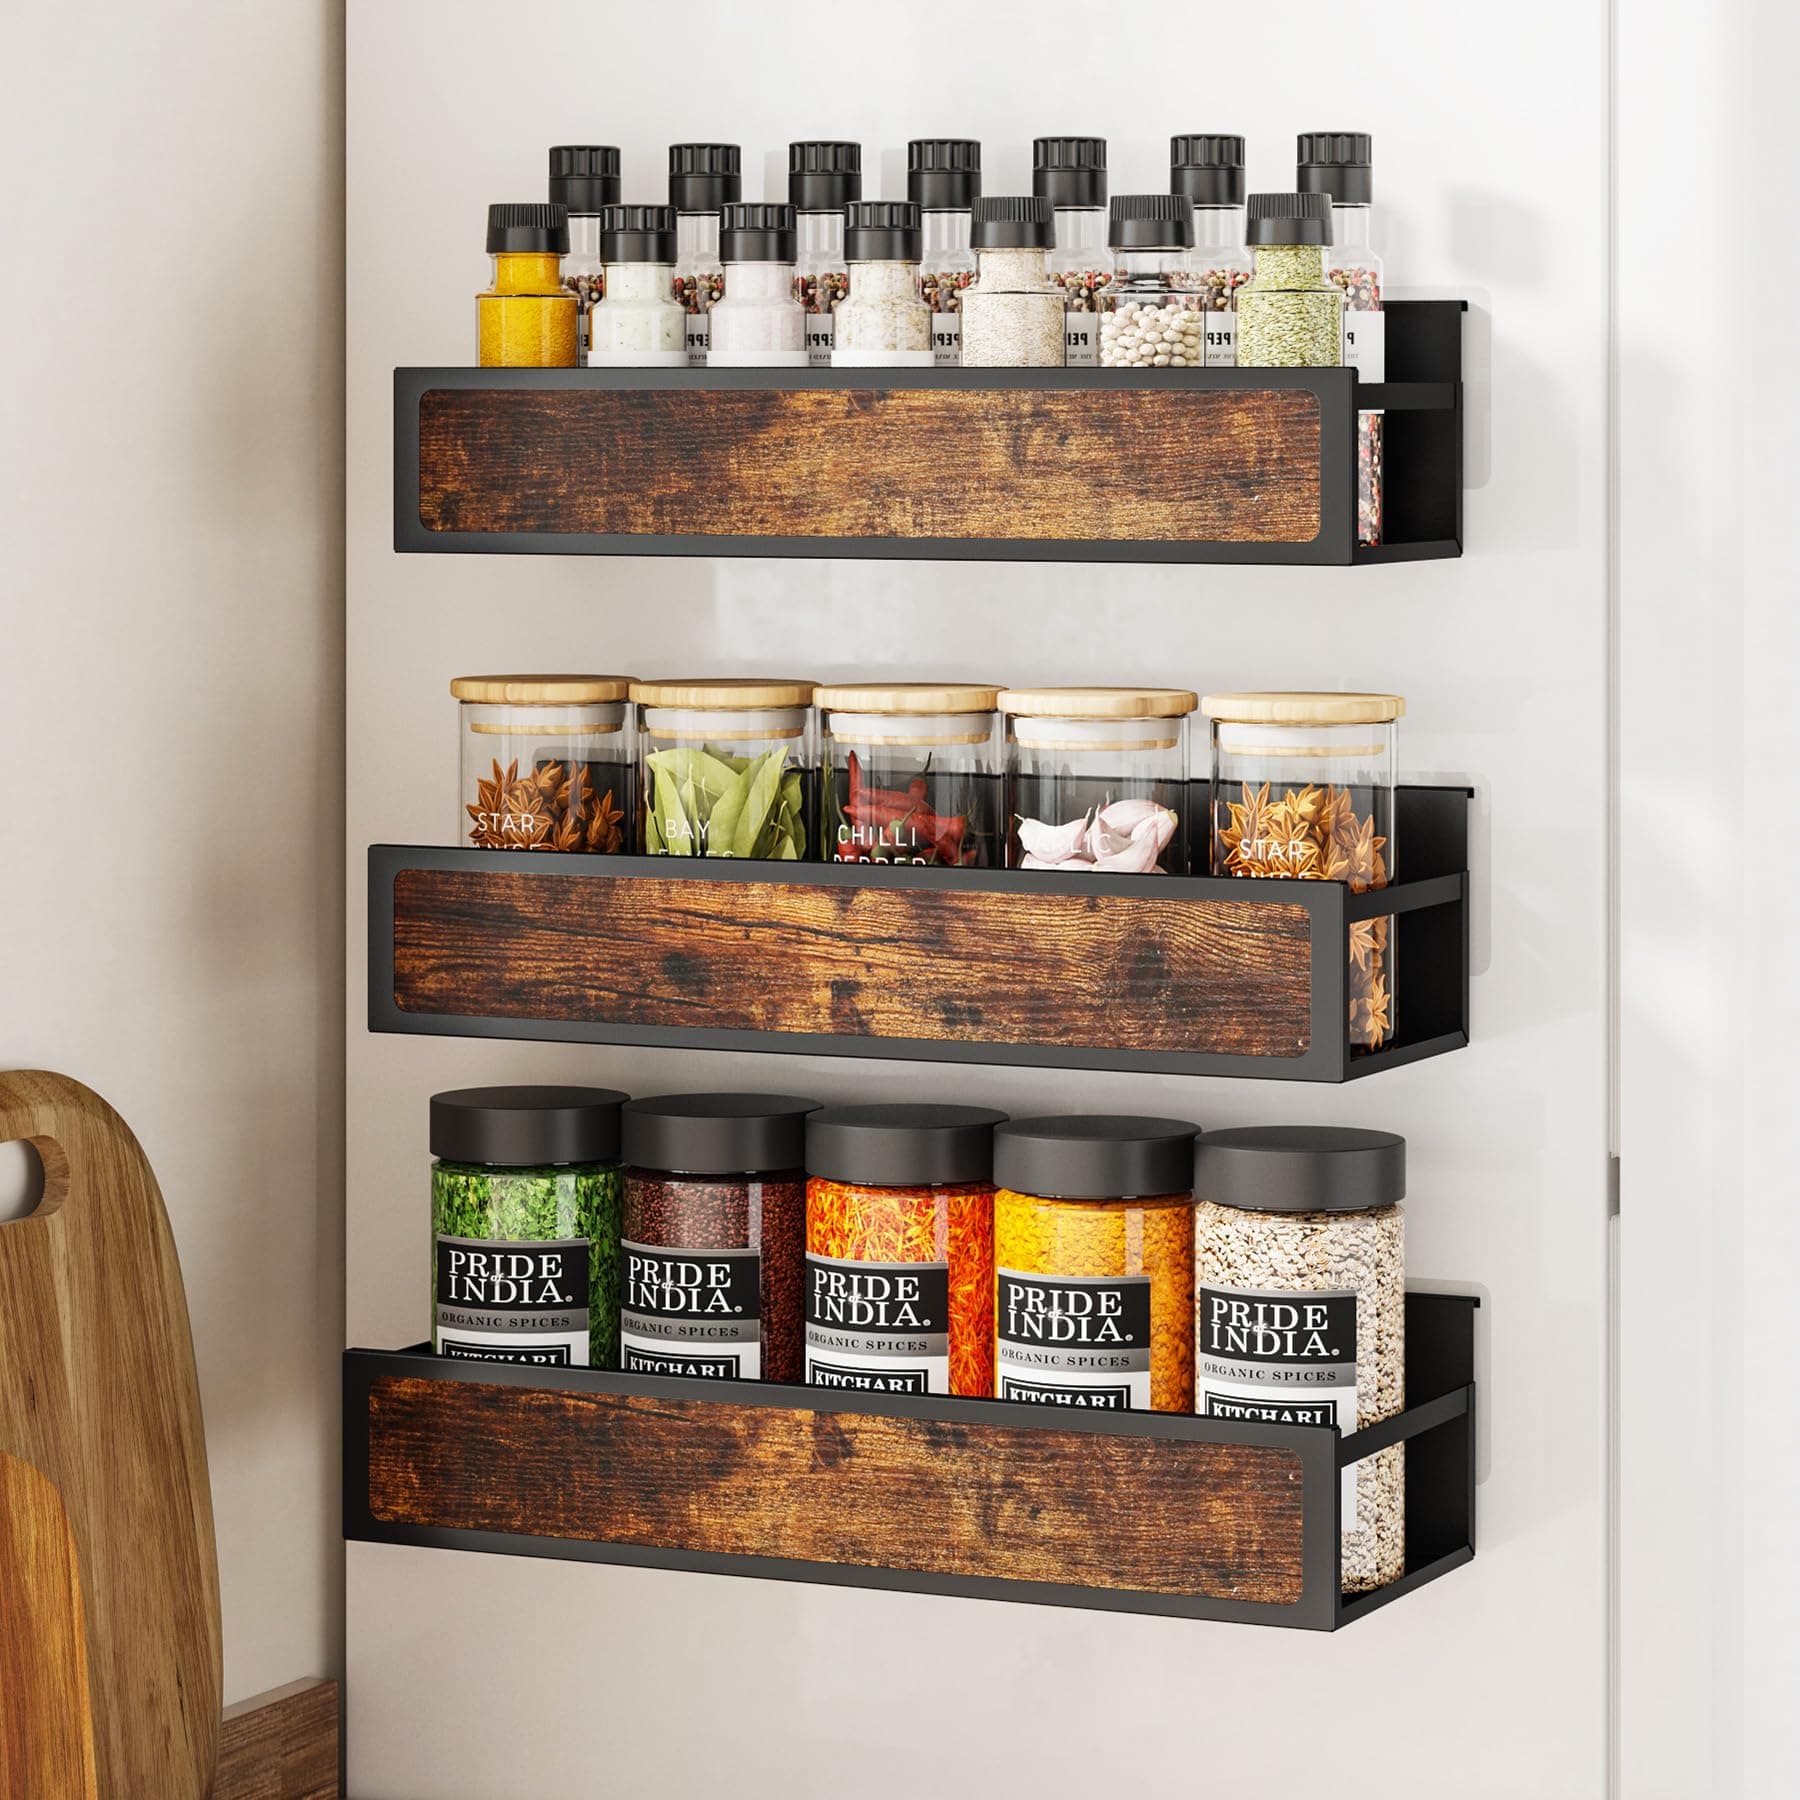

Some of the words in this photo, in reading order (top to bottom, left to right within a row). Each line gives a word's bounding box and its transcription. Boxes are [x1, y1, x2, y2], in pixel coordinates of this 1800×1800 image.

[477, 812, 535, 833] STAR
[665, 819, 710, 839] BAY
[837, 824, 916, 847] CHILLI
[1239, 838, 1303, 860] STAR
[449, 1250, 563, 1279] PRIDE
[629, 1256, 732, 1288] PRIDE
[814, 1268, 920, 1301] PRIDE
[1008, 1284, 1123, 1316] PRIDE
[442, 1312, 503, 1327] ORGANIC
[509, 1317, 570, 1327] SPICES
[1211, 1297, 1328, 1330] PRIDE
[624, 1317, 673, 1335] ORGANIC
[678, 1326, 740, 1337] SPICES
[808, 1331, 860, 1349] ORGANIC
[866, 1340, 928, 1351] SPICES
[1001, 1347, 1061, 1365] ORGANIC
[1067, 1356, 1131, 1366] SPICES
[1204, 1361, 1266, 1380] ORGANIC
[1272, 1371, 1337, 1382] SPICES
